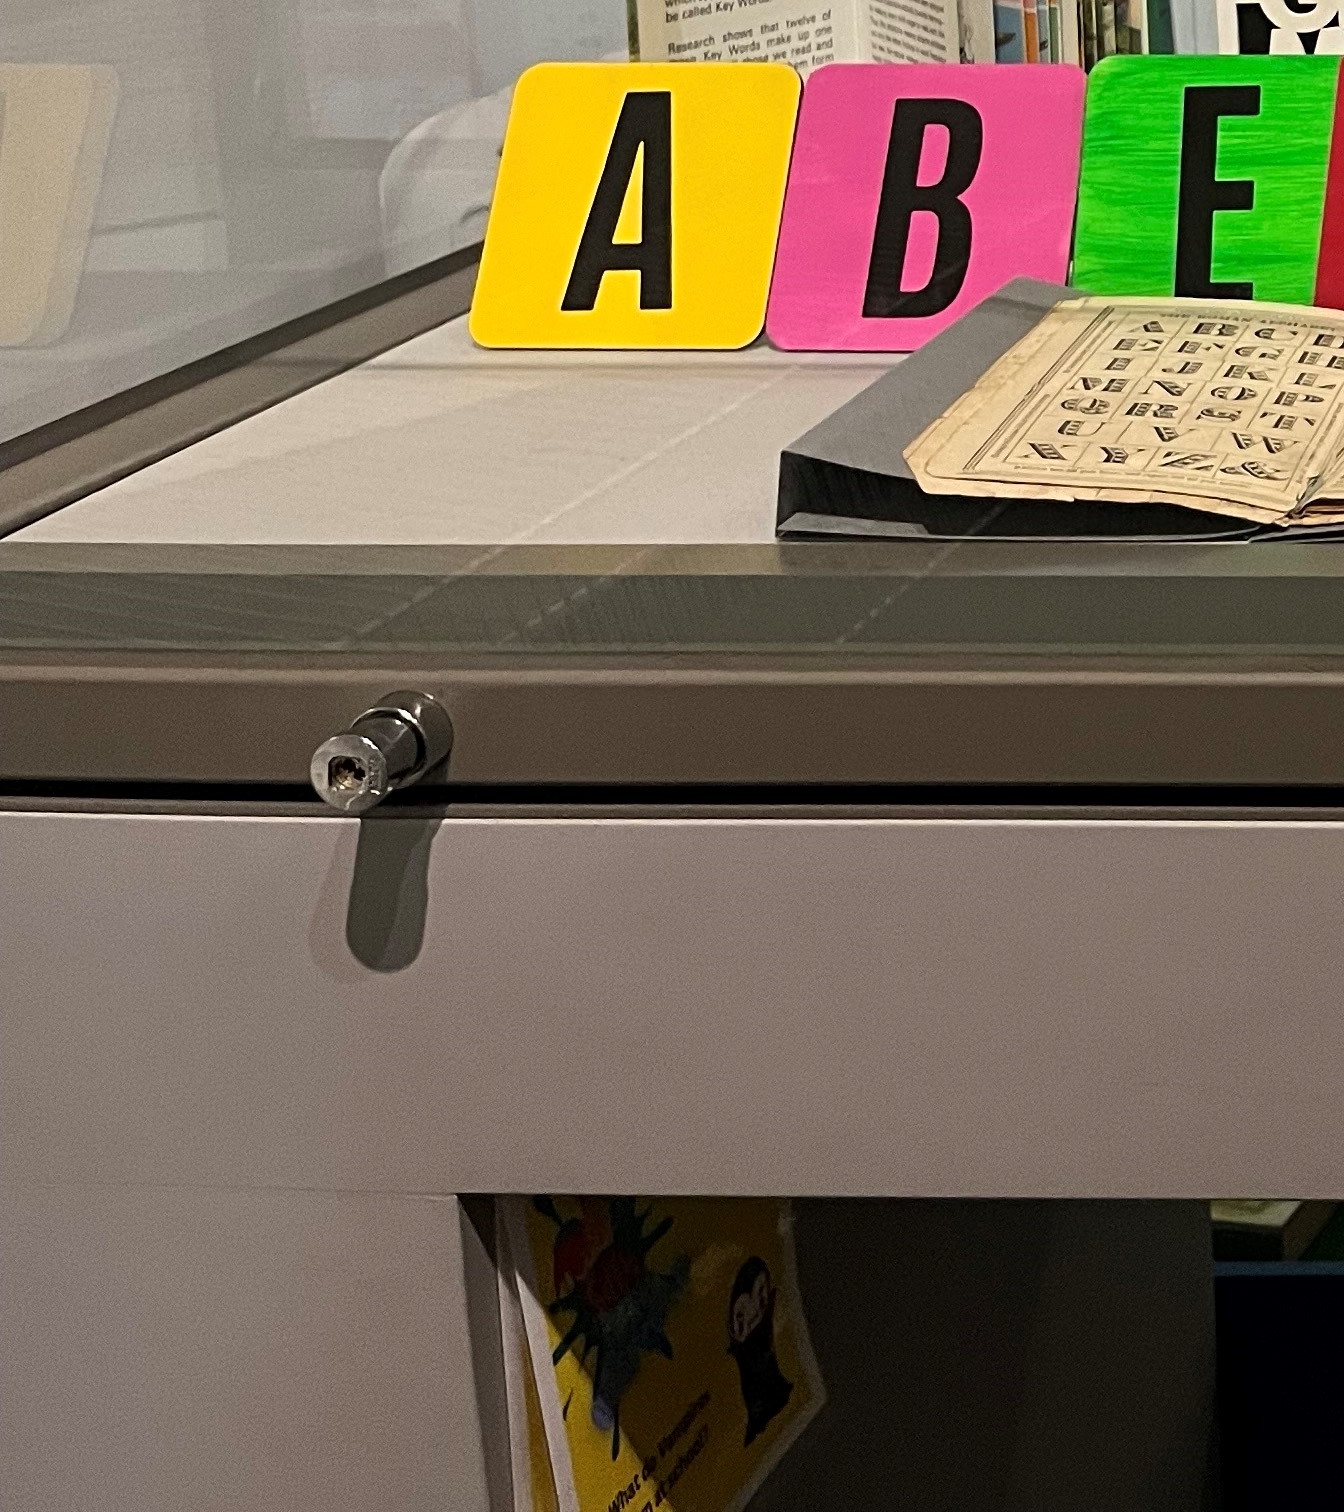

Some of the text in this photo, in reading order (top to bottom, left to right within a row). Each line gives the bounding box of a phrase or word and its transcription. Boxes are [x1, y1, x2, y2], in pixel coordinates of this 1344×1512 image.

[665, 10, 679, 23] be
[682, 3, 712, 18] called
[715, 0, 735, 12] Key
[668, 9, 832, 55] Research shows that twelve of
